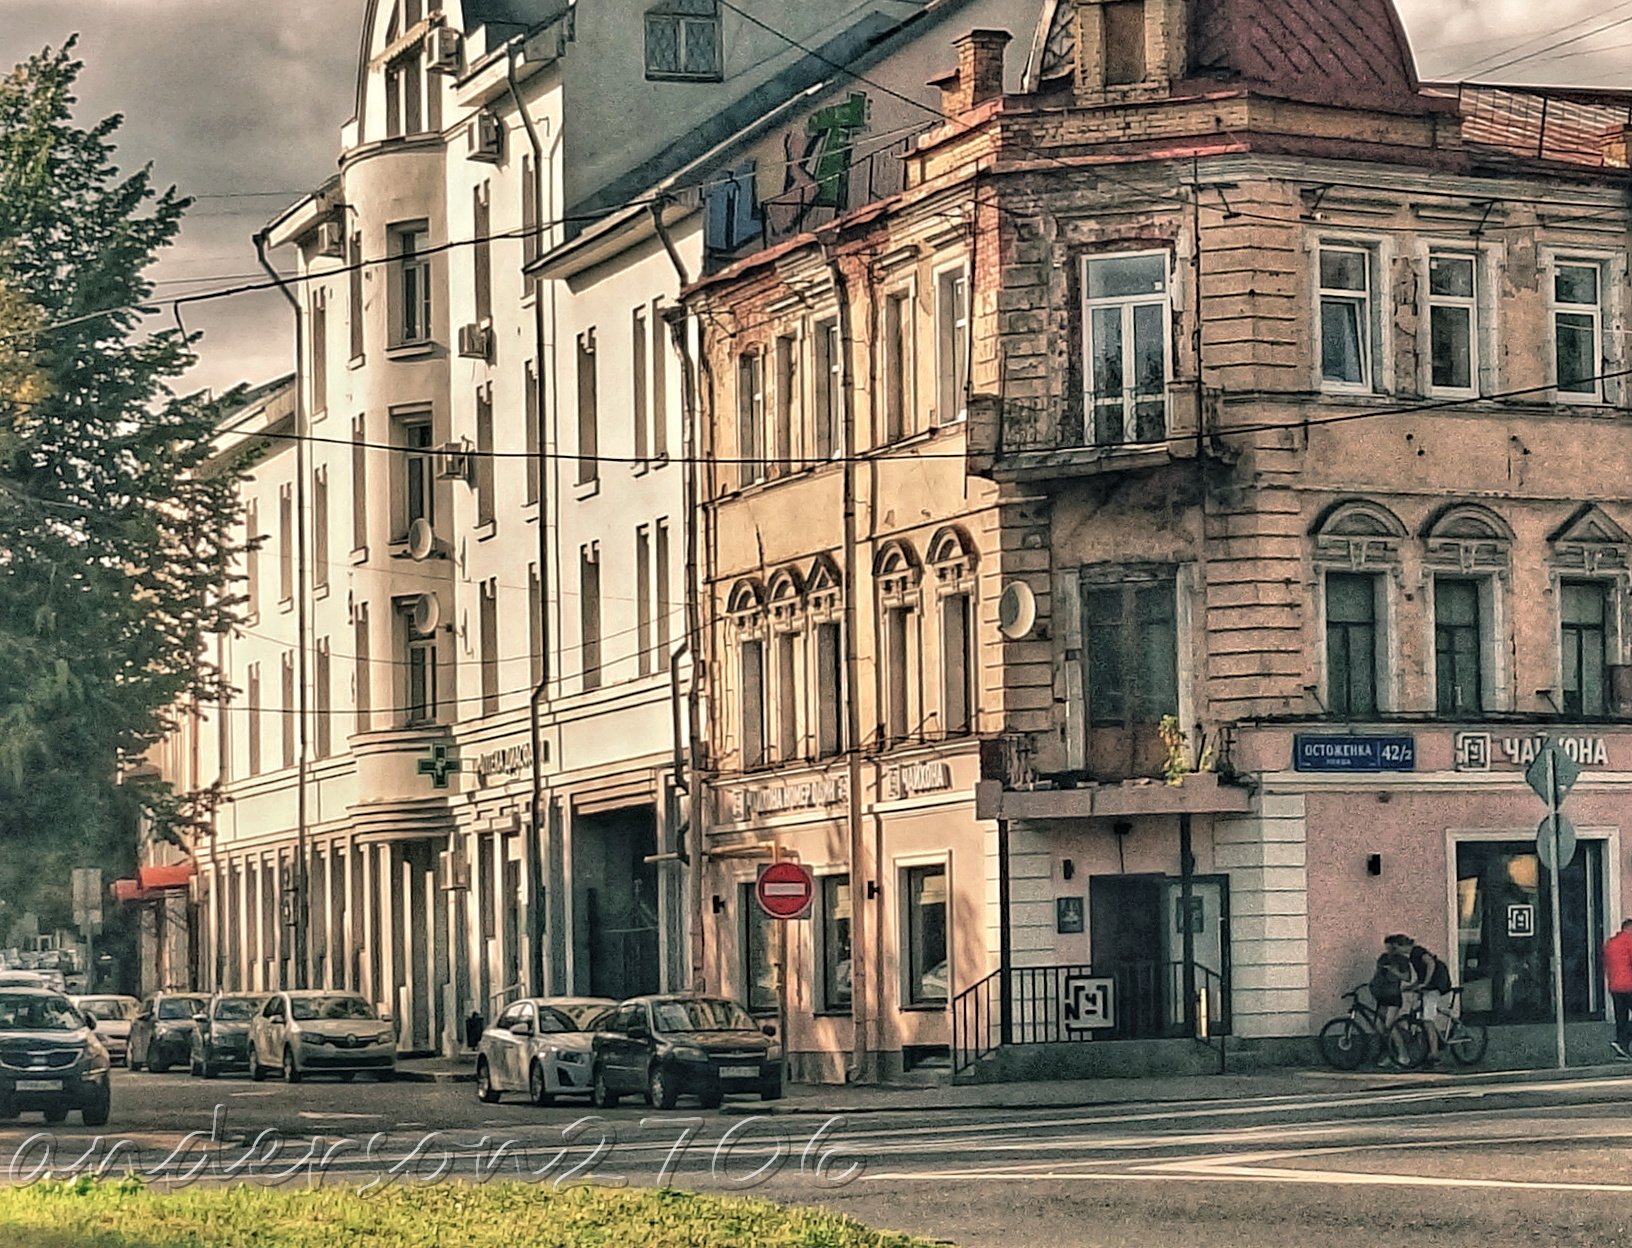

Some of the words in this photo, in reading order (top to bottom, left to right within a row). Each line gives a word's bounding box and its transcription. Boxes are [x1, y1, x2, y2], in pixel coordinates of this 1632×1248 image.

[1304, 744, 1373, 757] ОСТОЖЕНКА
[1381, 744, 1413, 762] 42/2
[1503, 732, 1609, 764] ЧАОНА
